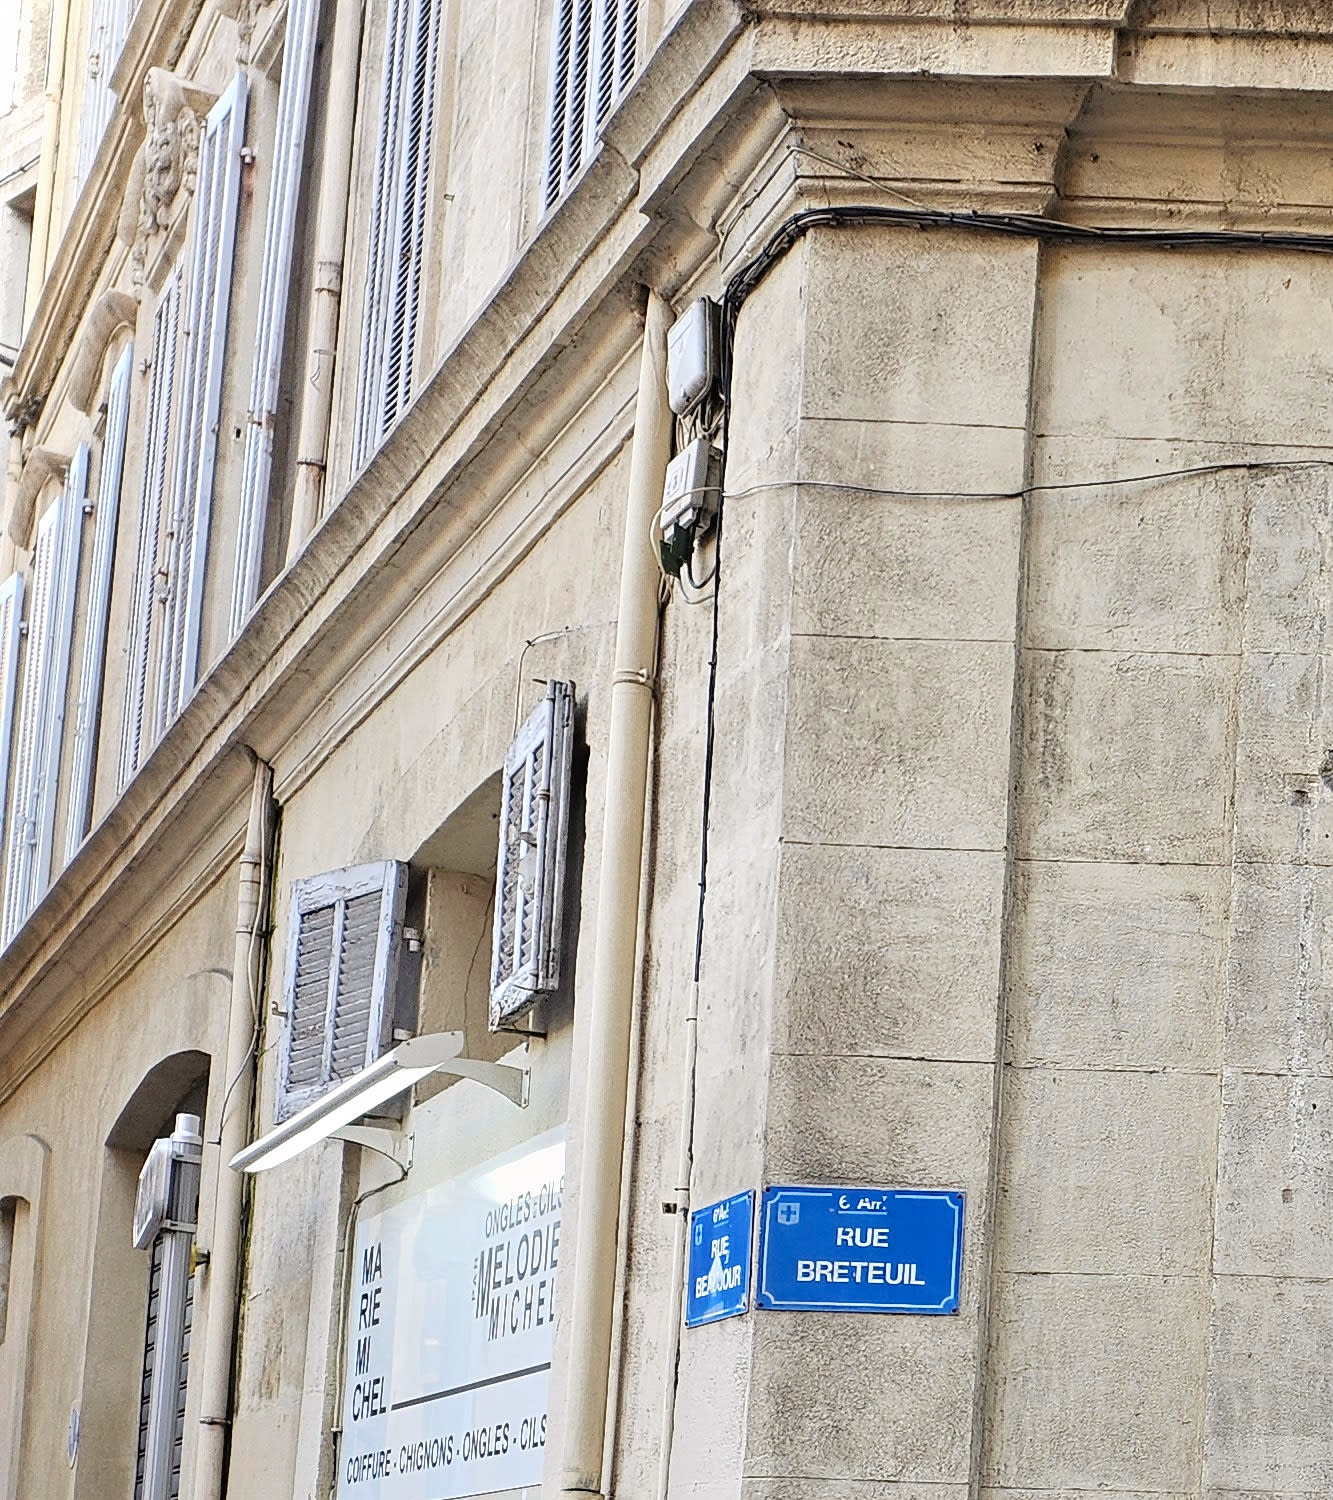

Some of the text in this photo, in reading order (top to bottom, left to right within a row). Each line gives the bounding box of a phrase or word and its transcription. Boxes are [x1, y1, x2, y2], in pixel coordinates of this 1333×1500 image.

[485, 1191, 532, 1239] ONGLES
[711, 1235, 729, 1259] RUE
[836, 1227, 889, 1248] RUE
[362, 1242, 382, 1286] MA
[476, 1220, 561, 1319] MELODIE
[796, 1260, 926, 1286] BRETEUIL
[359, 1287, 382, 1331] RIE
[488, 1277, 555, 1342] MICHEL
[355, 1336, 371, 1377] MI
[352, 1376, 387, 1422] CHEL
[346, 1448, 391, 1485] COIFFURE
[400, 1435, 453, 1474] CHIGNONS
[463, 1419, 510, 1463] ONGLES
[520, 1413, 548, 1451] CILS
